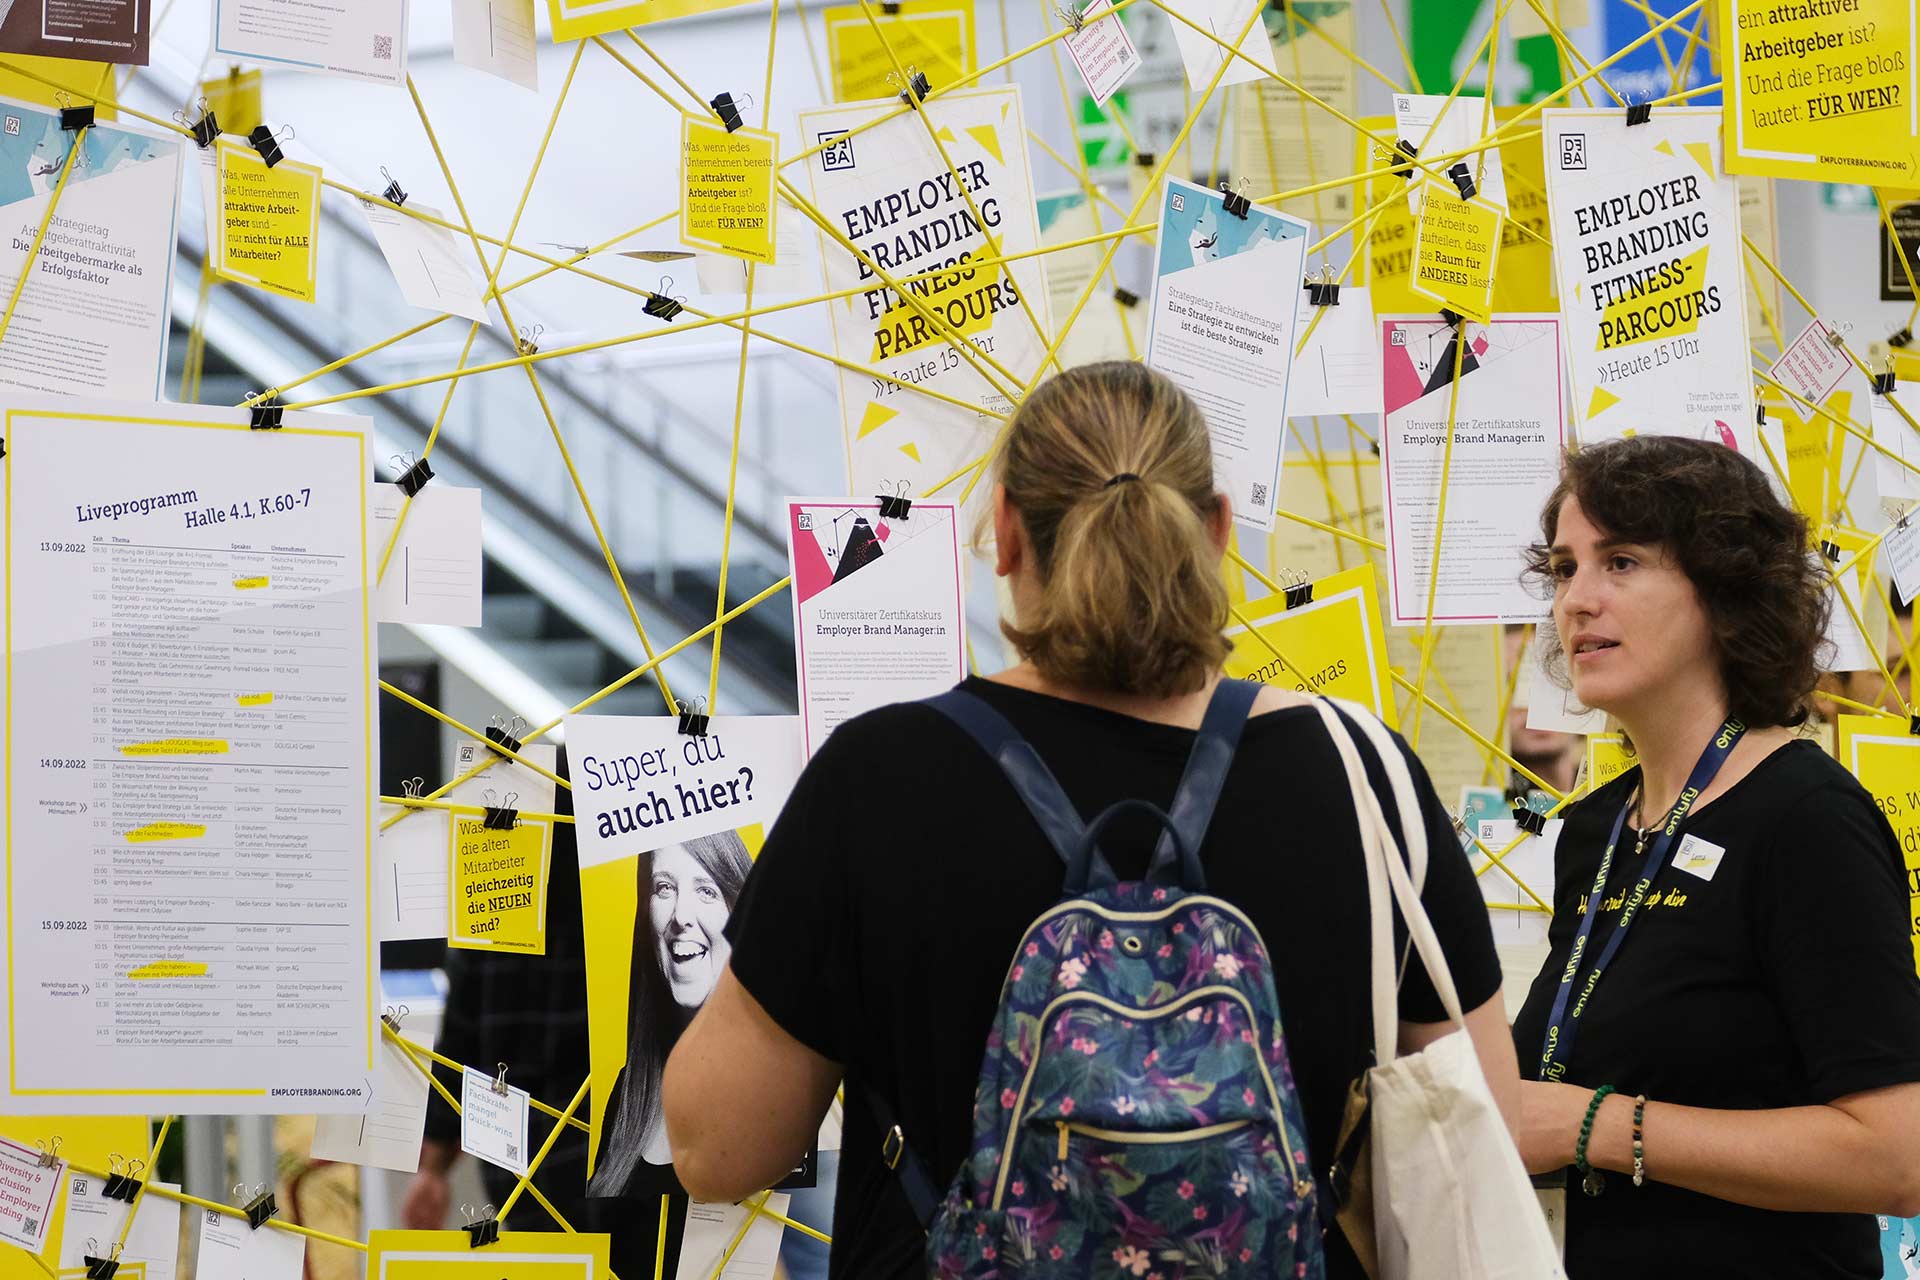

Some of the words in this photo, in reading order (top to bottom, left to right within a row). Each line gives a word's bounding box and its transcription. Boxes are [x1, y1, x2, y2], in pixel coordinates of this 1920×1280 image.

[1738, 9, 1765, 29] ein
[1769, 0, 1859, 25] attraktiver
[1073, 24, 1099, 53] Diversity
[1079, 35, 1106, 63] Inclusion
[1093, 36, 1120, 64] Employer
[1744, 32, 1844, 62] Arbeitgeber
[1849, 22, 1876, 45] ist?
[1090, 56, 1118, 84] Branding
[1747, 71, 1783, 95] Und
[1788, 69, 1813, 88] die
[1817, 62, 1863, 85] Frage
[1866, 51, 1905, 75] bloß
[1752, 104, 1803, 128] lautet:
[1807, 92, 1845, 119] FÜR
[1847, 85, 1901, 111] WEN?
[683, 142, 702, 154] Was,
[703, 144, 727, 153] wenn
[727, 142, 751, 155] jedes
[1564, 154, 1583, 165] BA
[685, 157, 743, 167] Unternehmen
[744, 158, 774, 167] bereits
[1820, 156, 1907, 170] EMPLOYERBRANDING.ORG
[221, 169, 240, 182] Was,
[242, 172, 266, 182] wenn
[687, 174, 700, 182] ein
[701, 173, 746, 183] attraktiver
[223, 186, 236, 195] alle
[238, 187, 300, 200] Unternehmen
[688, 188, 737, 200] Arbeitgeber
[739, 187, 753, 198] ist?
[842, 160, 990, 240] EMPLOYER
[1420, 194, 1441, 211] Was,
[1444, 201, 1471, 214] wenn
[224, 202, 266, 213] attraktive
[267, 204, 300, 214] Arbeit-
[690, 203, 707, 213] Und
[709, 203, 721, 213] die
[722, 203, 747, 215] Frage
[748, 202, 767, 213] bloß
[1575, 175, 1700, 236] EMPLOYER
[49, 214, 109, 239] Strategietag
[226, 217, 250, 229] geber
[252, 219, 269, 229] sind
[718, 216, 736, 229] FÜR
[738, 218, 764, 229] WEN?
[1420, 215, 1435, 226] wir
[1437, 217, 1465, 231] Arbeit
[1468, 224, 1479, 234] so
[21, 225, 136, 259] Arbitgeberattraktivität
[228, 233, 242, 243] nur
[244, 234, 267, 245] nicht
[269, 234, 282, 245] für
[284, 236, 309, 247] ALLE
[854, 198, 1001, 280] BRANDING
[1465, 239, 1487, 253] dass
[1583, 212, 1709, 273] BRANDING
[12, 238, 30, 251] Die
[36, 244, 126, 272] rbeitgebermarke
[127, 264, 142, 276] als
[229, 248, 282, 261] Mitarbeiter?
[1420, 250, 1433, 261] sie
[1435, 251, 1464, 267] Raum
[1466, 256, 1481, 269] für
[41, 261, 110, 285] Erfolgsfaktor
[1420, 266, 1468, 285] ANDERES
[1591, 258, 1692, 311] FITNESS-
[1168, 286, 1214, 311] Strategietag
[1168, 301, 1187, 315] Eine
[1188, 307, 1223, 328] Strategie
[1224, 321, 1235, 331] zu
[1235, 325, 1280, 346] entwickeln
[1599, 285, 1721, 349] PARCOURS
[1181, 320, 1192, 330] ist
[1192, 323, 1205, 335] die
[1206, 328, 1227, 343] beste
[1228, 335, 1263, 355] Strategie
[1806, 333, 1829, 364] Diversity
[939, 346, 960, 372] 15
[1653, 346, 1669, 367] 15
[1672, 337, 1700, 359] Uhr
[1799, 342, 1823, 374] Inclusion
[1784, 359, 1808, 391] Branding
[1798, 360, 1823, 391] Employer
[1472, 418, 1541, 430] Zertifikatskurs
[1403, 434, 1450, 446] Employe
[1455, 433, 1485, 443] Brand
[1487, 433, 1546, 445] Manager:in
[77, 489, 198, 522] Liveprogramm
[185, 509, 226, 528] Halle
[230, 504, 257, 522] 4.1,
[260, 488, 312, 516] K.60-7
[40, 542, 86, 553] 13.09.2022
[819, 609, 877, 621] Universitärer
[880, 609, 943, 621] Zertifikatskurs
[817, 624, 862, 638] Employer
[864, 625, 892, 636] Brand
[894, 625, 946, 638] Manager:in
[1242, 657, 1285, 683] enn
[40, 759, 87, 769] 14.09.2022
[583, 747, 678, 792] Super,
[683, 735, 725, 766] du
[597, 790, 674, 838] auch
[675, 767, 754, 817] hier?
[1665, 786, 1698, 837] onlyfy
[459, 822, 486, 836] Was,
[461, 842, 479, 856] die
[481, 838, 510, 853] alten
[464, 855, 525, 875] Mitarbeiter
[465, 874, 534, 897] gleichzeitig
[467, 901, 486, 915] die
[488, 893, 532, 911] NEUEN
[1620, 878, 1651, 927] onlyfy
[41, 921, 88, 931] 15.09.2022
[470, 918, 501, 934] sind?
[1572, 967, 1602, 1018] onlyfy
[271, 1088, 362, 1096] EMPLOYERBRANDING.ORG
[469, 1102, 498, 1119] mangel
[469, 1112, 513, 1139] Quick-wins
